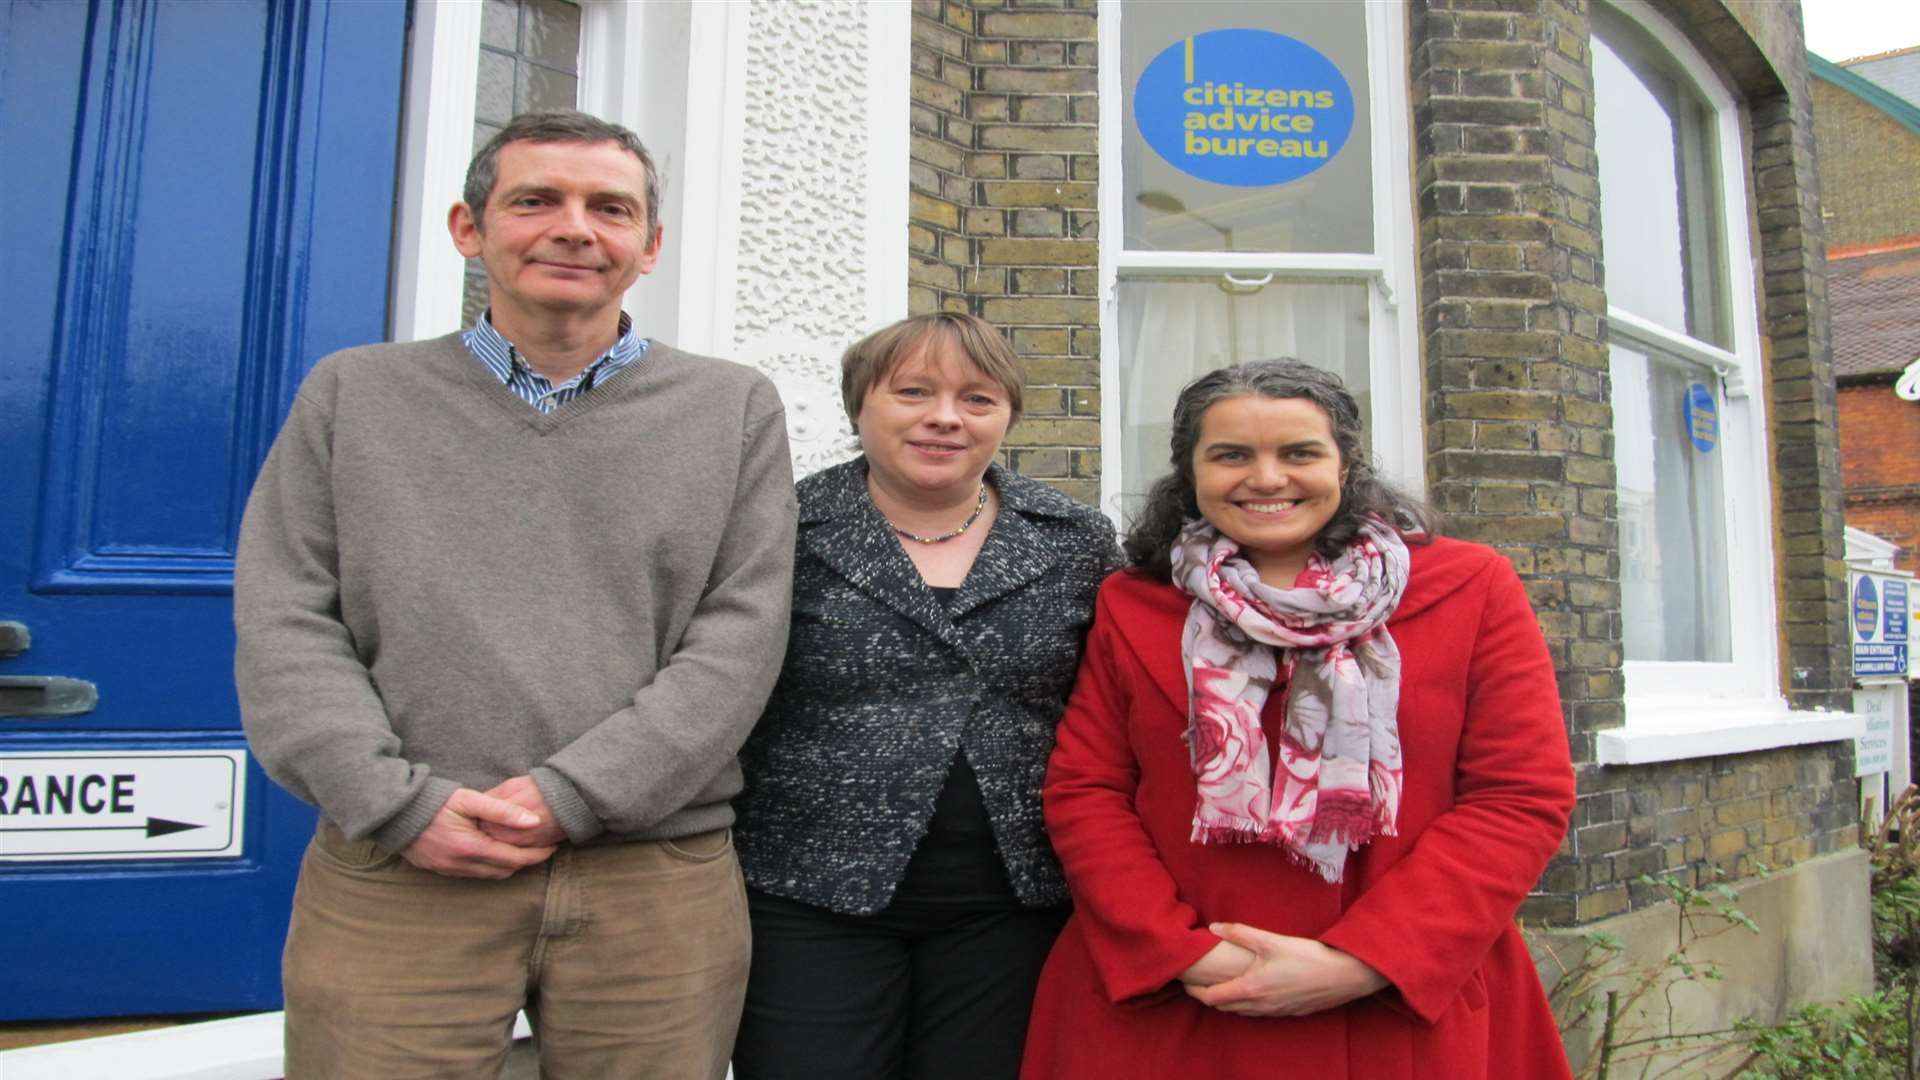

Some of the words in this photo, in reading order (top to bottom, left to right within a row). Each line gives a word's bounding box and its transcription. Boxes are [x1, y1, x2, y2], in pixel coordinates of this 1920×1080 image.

[1184, 82, 1335, 108] citizens
[1184, 108, 1314, 133] advice
[1184, 131, 1328, 158] bureau
[1860, 736, 1887, 750] Services
